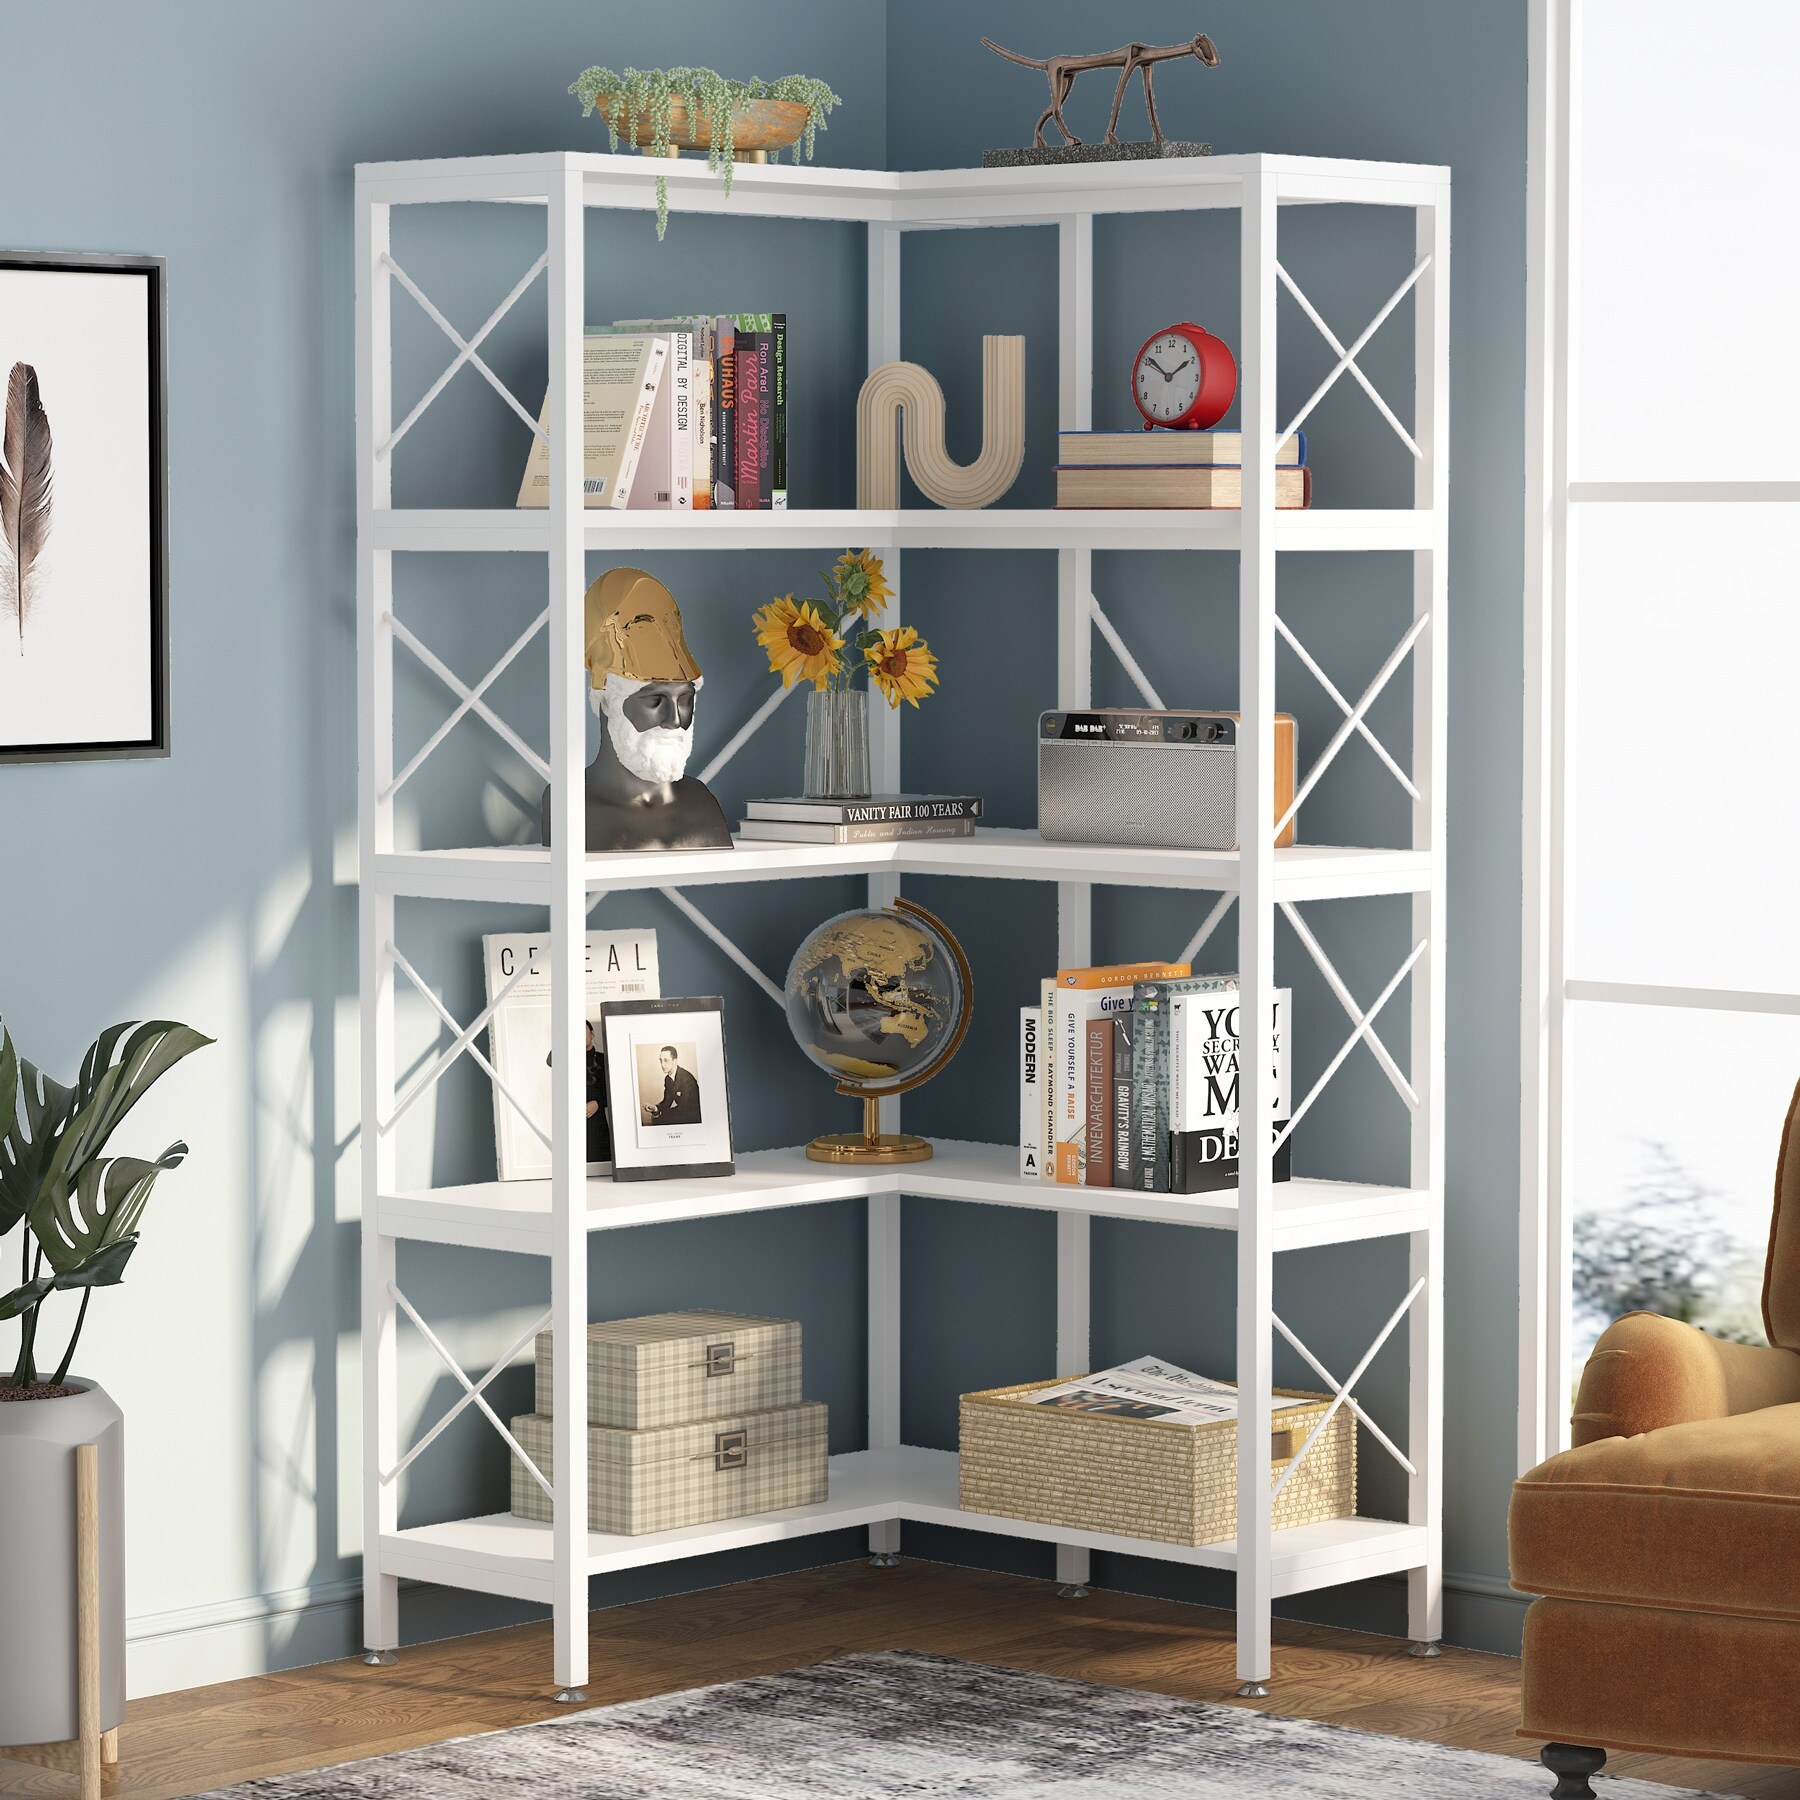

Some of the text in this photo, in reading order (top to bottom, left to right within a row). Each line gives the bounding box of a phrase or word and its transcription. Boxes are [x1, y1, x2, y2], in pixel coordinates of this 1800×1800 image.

[677, 333, 688, 372] DIGITAL
[775, 334, 784, 363] Design
[1168, 340, 1176, 348] 12
[677, 378, 688, 390] BY
[722, 337, 734, 409] BAUHAUS
[740, 354, 758, 404] Parr
[677, 395, 688, 431] DESIGN
[760, 343, 769, 468] Ron Arad No Discipline
[1153, 404, 1157, 412] 7
[1179, 403, 1182, 411] 5
[634, 403, 650, 452] ARCHITECTURE
[740, 409, 758, 480] Martin
[1075, 724, 1088, 732] DAB
[847, 803, 963, 821] VANITY FAIR 100 YEARS
[853, 830, 876, 838] Public
[880, 828, 894, 837] and
[897, 827, 923, 835] Indian
[926, 826, 956, 835] Housing
[501, 944, 647, 976] CEEAL
[1101, 970, 1184, 983] GORDON BENNETT
[1101, 996, 1125, 1011] Give
[1025, 1018, 1036, 1083] MODERN
[1203, 1034, 1280, 1054] SECRY
[1090, 1031, 1103, 1164] INNENARCHITEKTUR
[1142, 1082, 1156, 1108] MOSAIC
[1176, 1092, 1179, 1100] ME
[1118, 1086, 1129, 1171] GRAVITY'S RAINBOW
[1142, 1108, 1156, 1156] MATHEMATICAL
[1026, 1154, 1035, 1167] A
[1140, 1365, 1168, 1376] The
[1102, 1383, 1184, 1400] second
[1176, 1397, 1232, 1412] term
